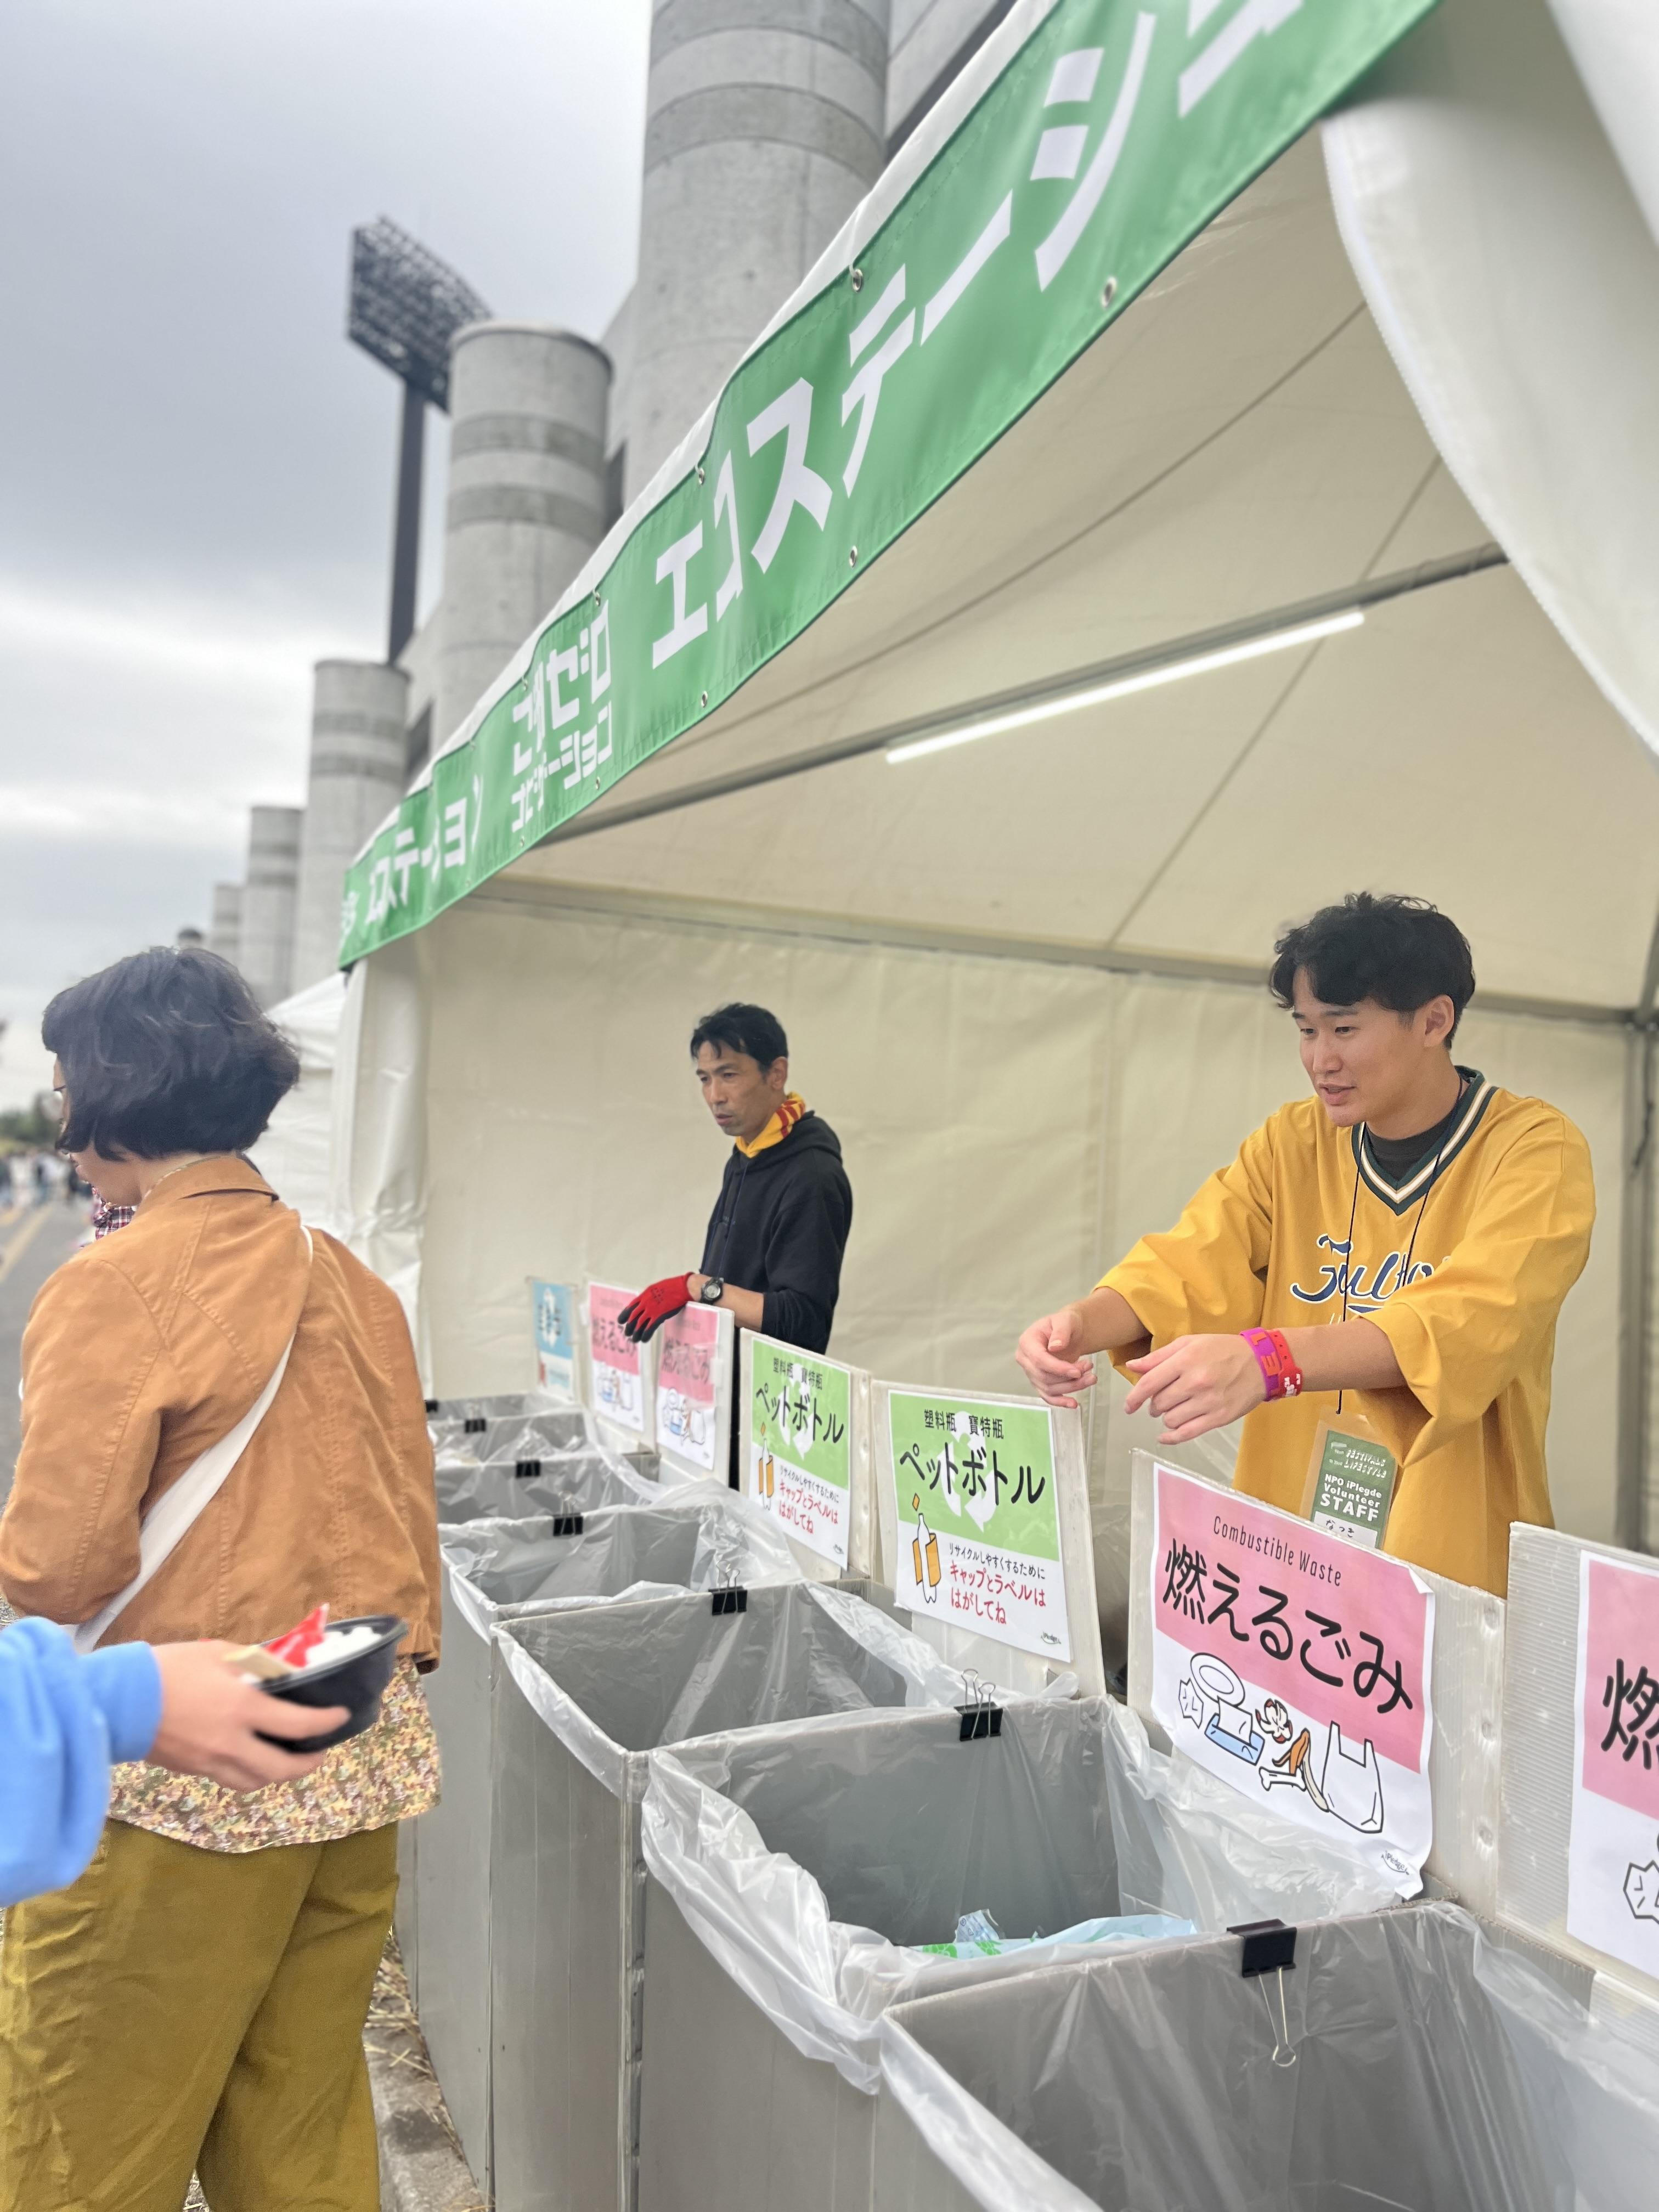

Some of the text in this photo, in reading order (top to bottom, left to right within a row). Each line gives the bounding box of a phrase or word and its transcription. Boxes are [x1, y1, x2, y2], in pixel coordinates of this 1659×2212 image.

[755, 1382, 844, 1443] ペットボトル
[924, 1408, 957, 1432] 塑料瓶
[780, 1465, 839, 1504] リサイクルしやすくするために
[899, 1441, 1046, 1506] ペットボトル
[1324, 1473, 1383, 1499] NPO iPlegde
[780, 1479, 839, 1525] キャップとラベルは
[1320, 1493, 1379, 1522] STAFF
[1323, 1482, 1380, 1508] Volunteer
[778, 1500, 814, 1534] はがしてね
[949, 1542, 1046, 1580] リサイクルしやすくするために
[1213, 1515, 1342, 1587] Combustible Waste
[950, 1559, 1046, 1607] キャップとラベルは
[951, 1586, 1007, 1624] はがしてね
[1163, 1538, 1414, 1714] 燃えるごみ
